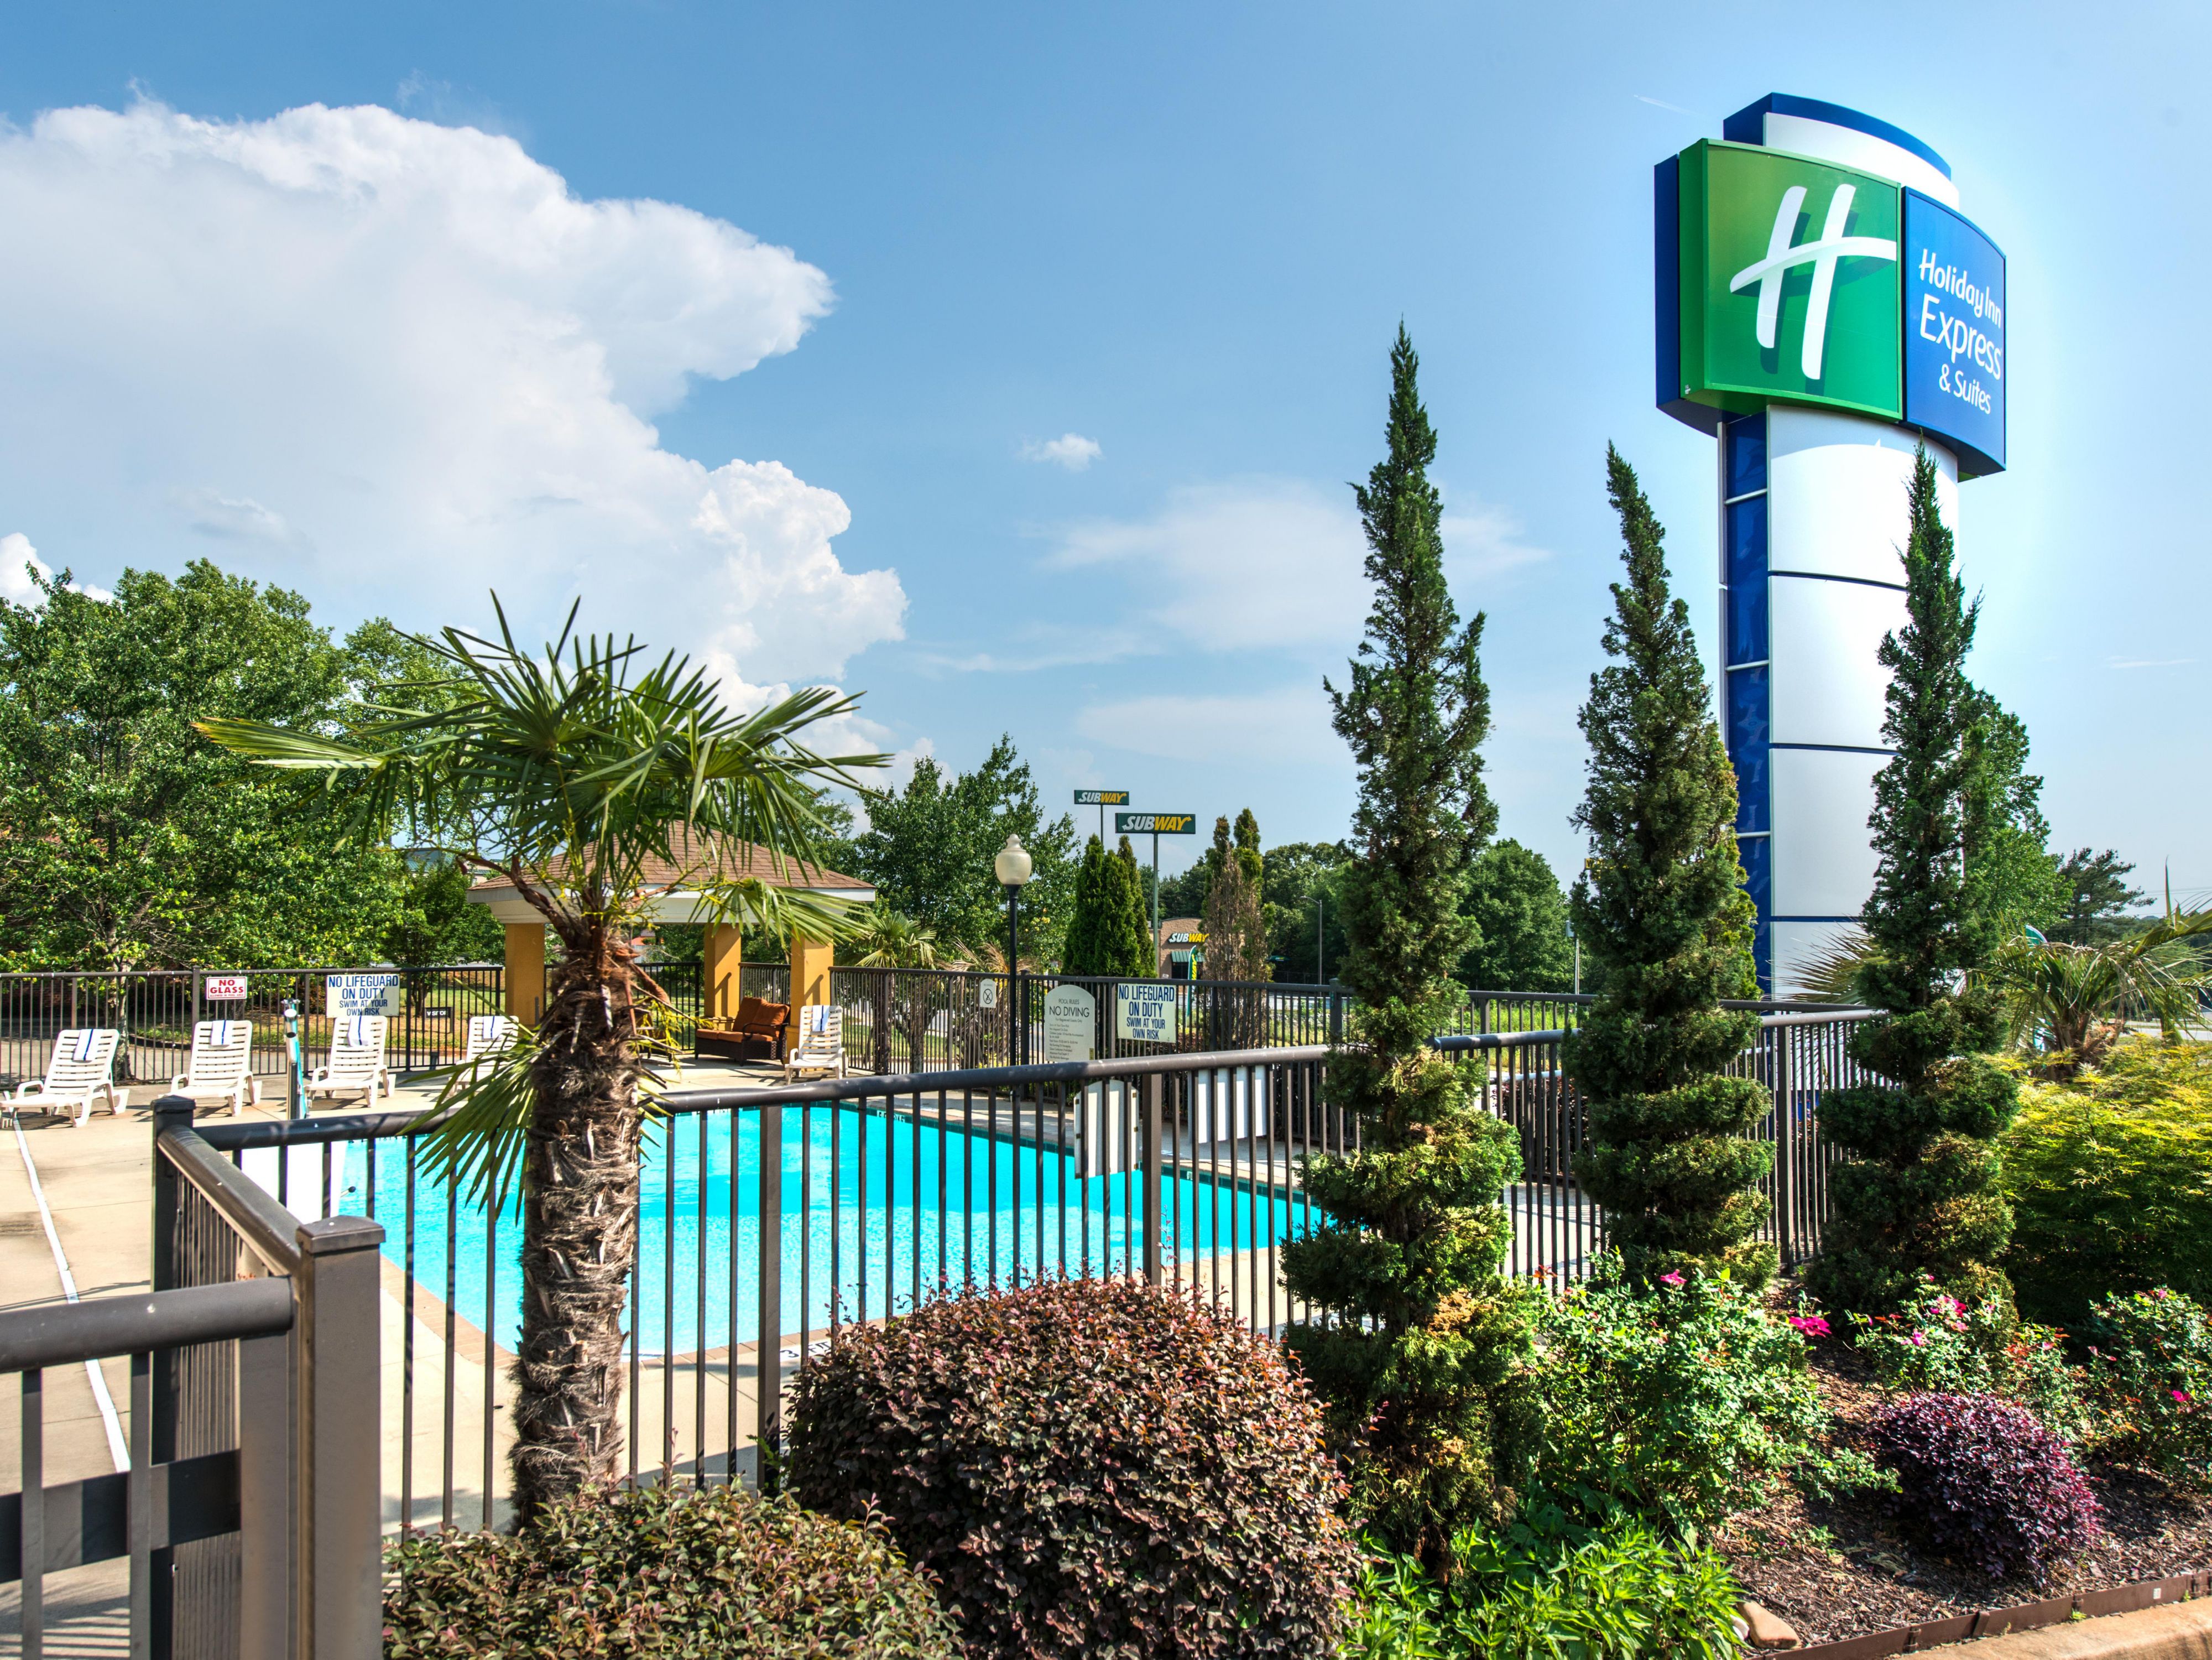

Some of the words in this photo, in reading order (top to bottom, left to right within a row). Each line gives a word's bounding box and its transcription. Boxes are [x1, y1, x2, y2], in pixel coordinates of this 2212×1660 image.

[1918, 248, 1984, 318] Holiday
[1985, 286, 2001, 329] Inn
[1919, 293, 2001, 380] Express
[1938, 363, 1950, 393] &
[1953, 370, 1991, 414] Suites
[1078, 792, 1126, 803] SUBWAY
[1121, 816, 1192, 831] SUBWAY
[1169, 933, 1209, 943] SUBWAY
[328, 976, 342, 987] NO
[346, 975, 398, 987] LIFEGUARD
[342, 988, 355, 999] ON
[359, 987, 385, 999] DUTY
[1119, 985, 1129, 1000] NO
[1132, 986, 1175, 1002] LIFEGUARD
[1049, 1006, 1061, 1016] NO
[1063, 1007, 1089, 1017] DIVING
[1129, 1001, 1139, 1016] ON
[1142, 1002, 1163, 1018] DUTY
[1126, 1017, 1141, 1028] SWIM
[1143, 1018, 1150, 1028] AT
[1151, 1019, 1165, 1029] YOUR
[1133, 1028, 1145, 1039] OWN
[1147, 1029, 1159, 1040] RISK
